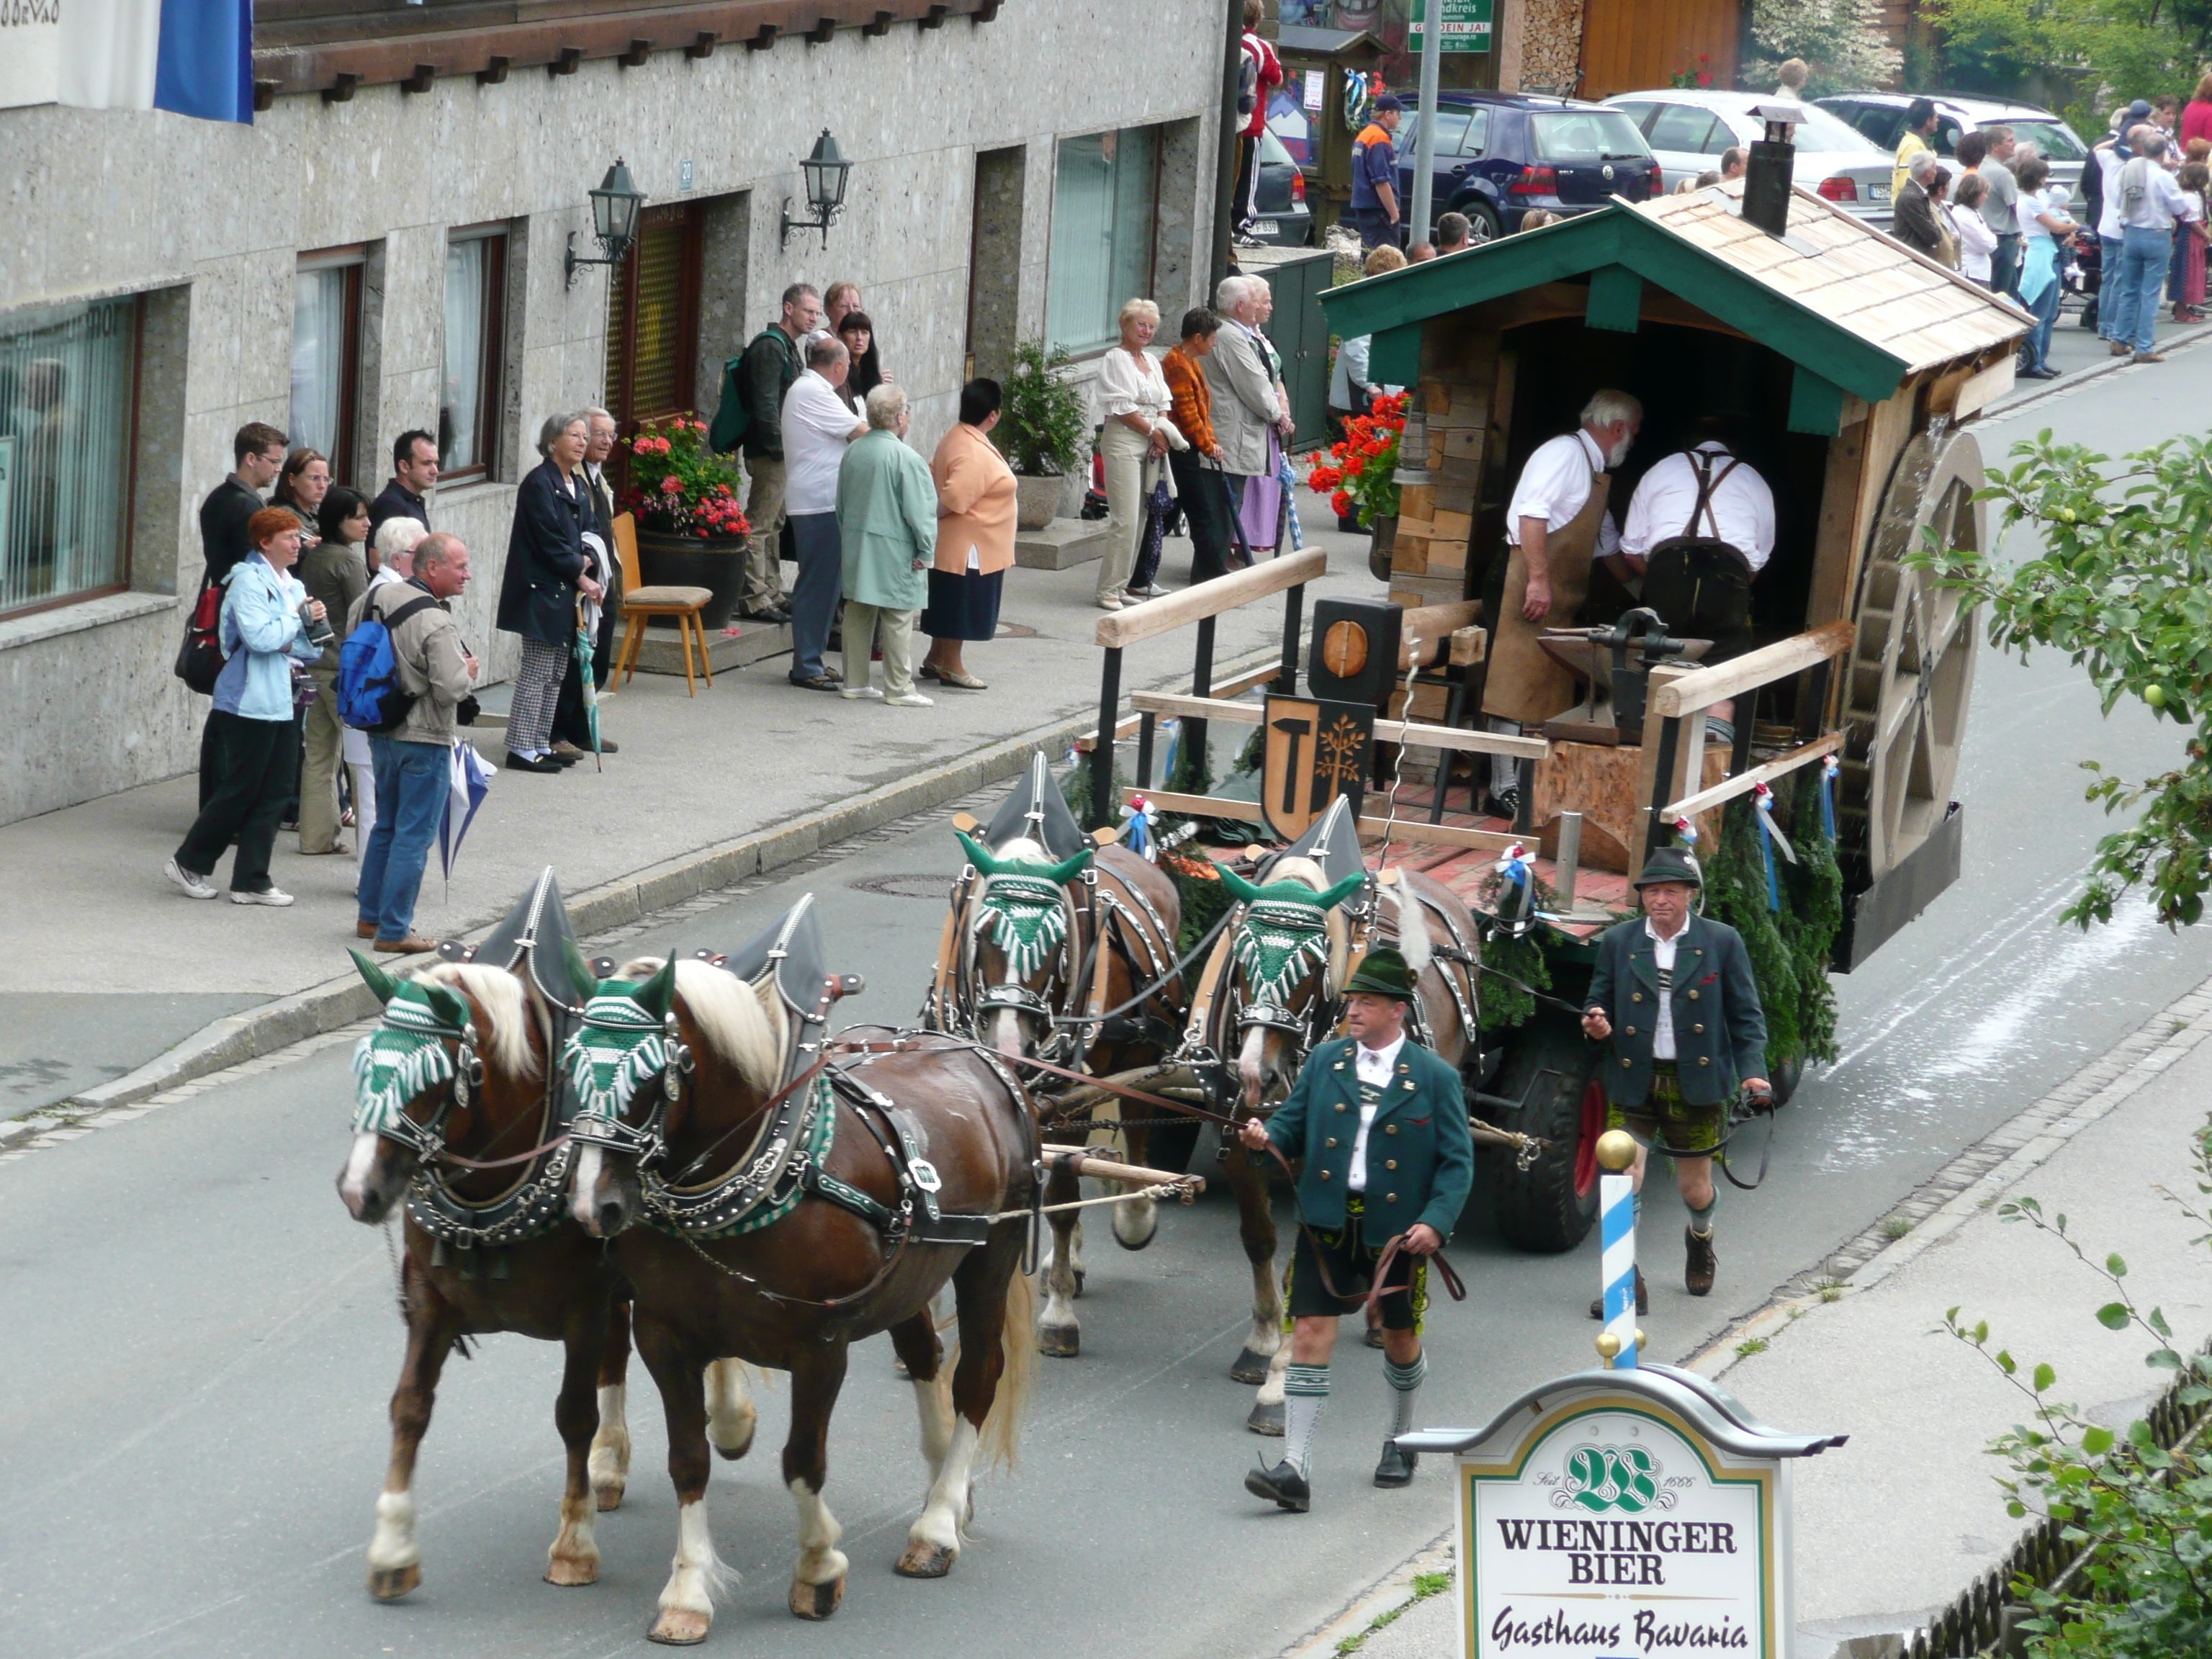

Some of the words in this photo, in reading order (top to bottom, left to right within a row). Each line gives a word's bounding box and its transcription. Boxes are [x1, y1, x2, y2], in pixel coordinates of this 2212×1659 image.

[1441, 3, 1476, 12] ndkreis
[1262, 222, 1277, 232] 839
[1532, 1471, 1560, 1486] Seit
[1662, 1475, 1697, 1488] 1666
[1496, 1519, 1737, 1554] WIENINGER
[1568, 1552, 1666, 1586] BIER
[1491, 1605, 1621, 1652] Gasthaus
[1633, 1609, 1748, 1655] Bavaria
